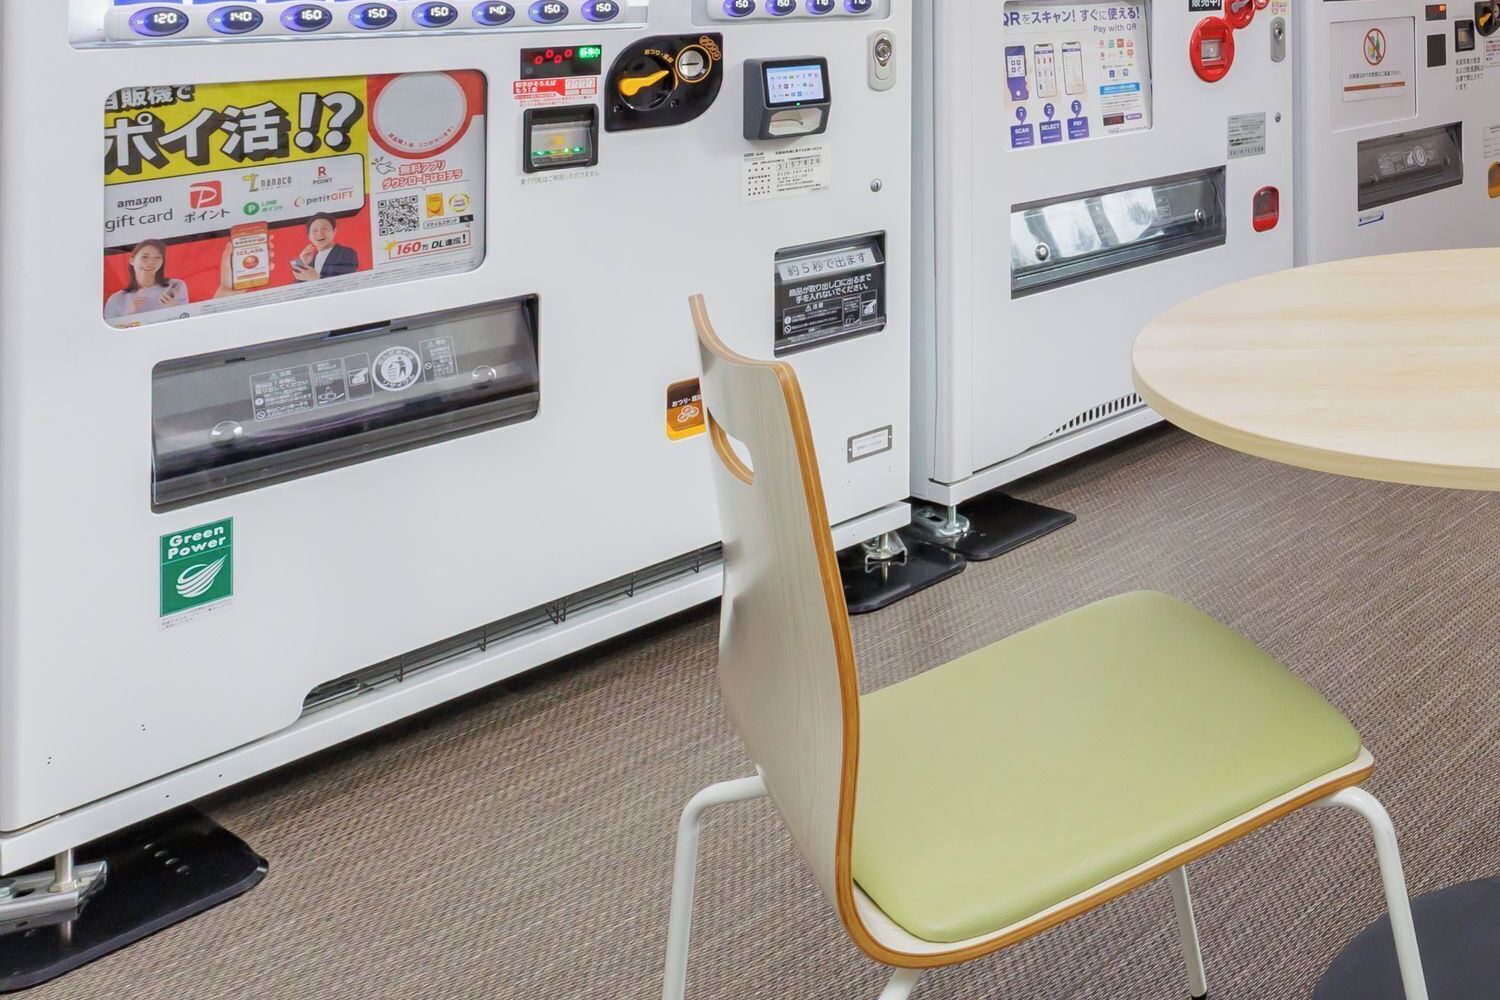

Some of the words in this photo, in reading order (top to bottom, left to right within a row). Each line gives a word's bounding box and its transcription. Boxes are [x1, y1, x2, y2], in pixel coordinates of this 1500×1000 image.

[430, 7, 449, 17] 150
[489, 5, 506, 15] 140
[544, 5, 560, 13] 150
[596, 3, 612, 12] 150
[153, 12, 177, 24] 120
[229, 11, 252, 22] 140
[301, 9, 322, 20] 160
[368, 8, 388, 19] 150
[1080, 6, 1140, 21] すぐに使える!
[1093, 25, 1106, 34] Pay
[1108, 24, 1124, 32] with
[1126, 23, 1137, 31] QR
[1041, 123, 1060, 131] SELECT
[117, 195, 162, 209] amazon
[105, 214, 135, 232] gift
[139, 208, 173, 225] card
[184, 208, 230, 223] ポイント
[169, 526, 224, 547] Green
[168, 536, 226, 559] Power
